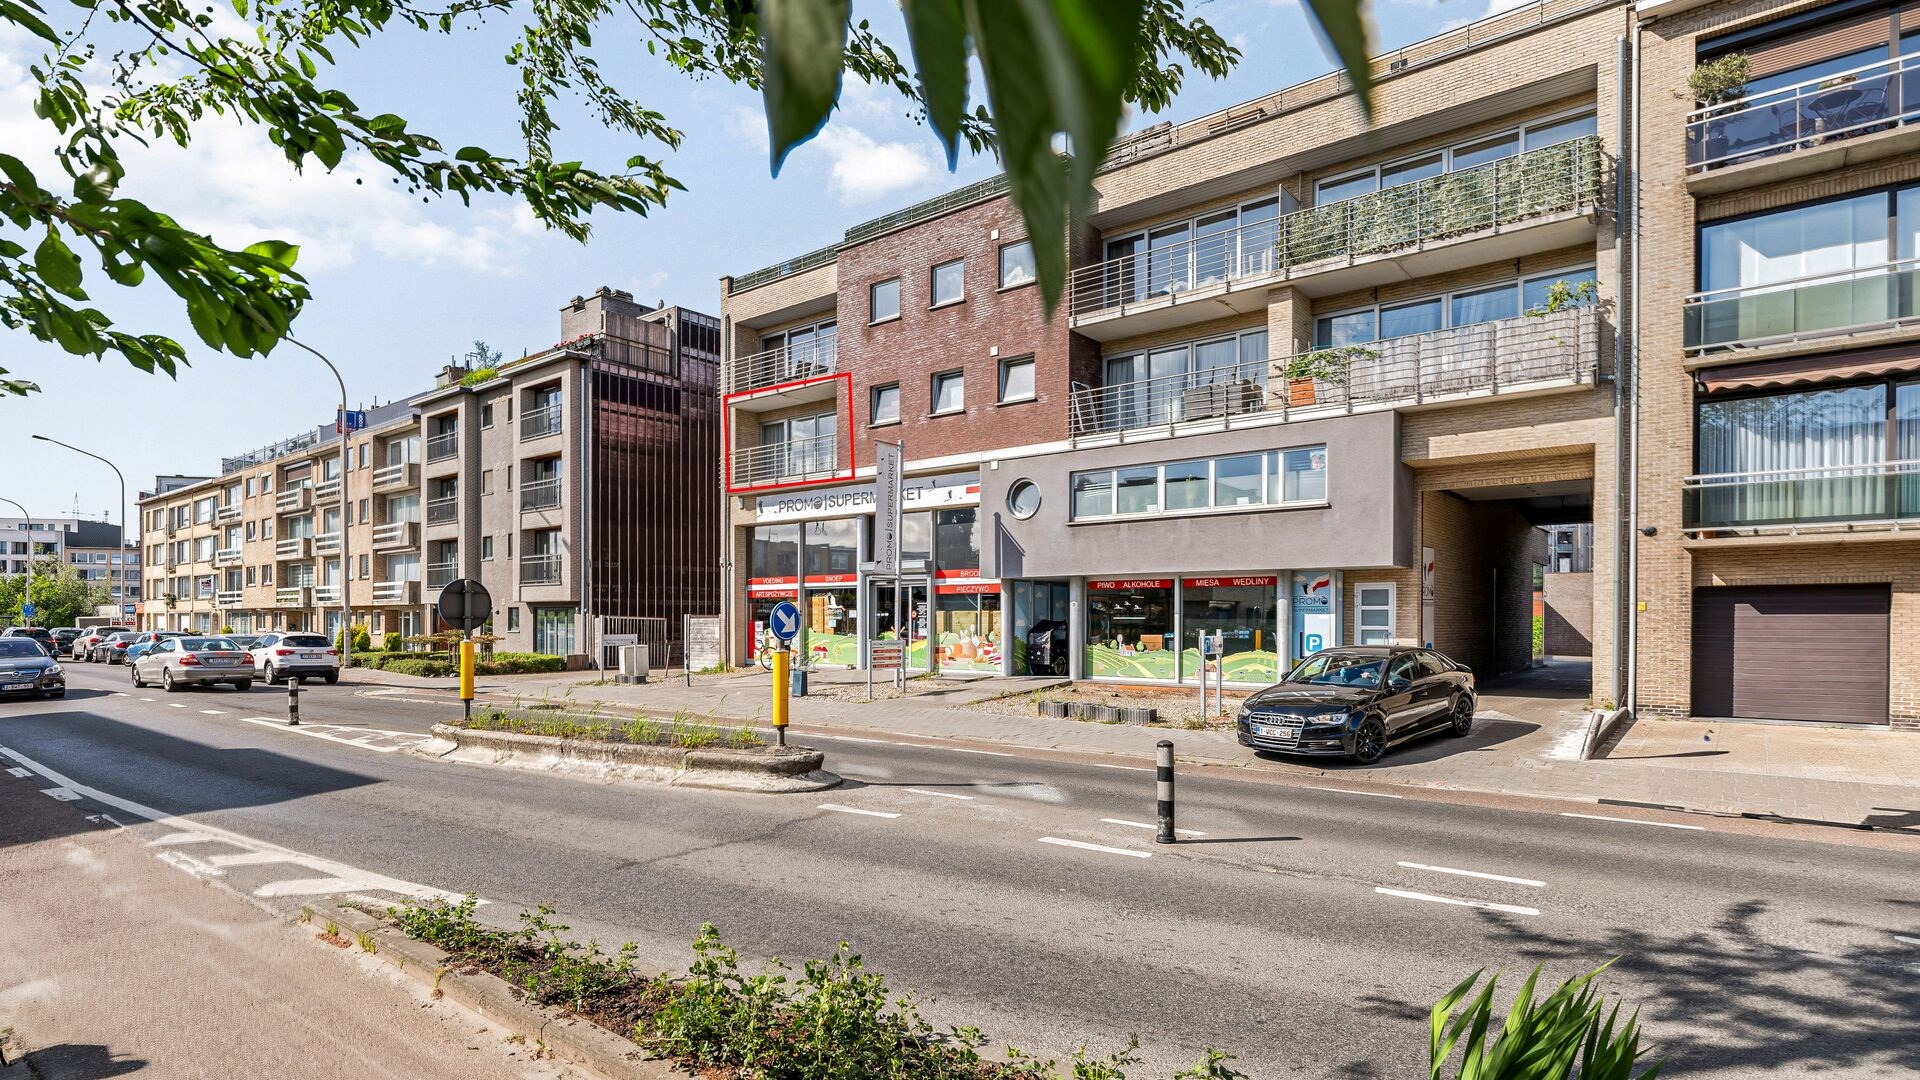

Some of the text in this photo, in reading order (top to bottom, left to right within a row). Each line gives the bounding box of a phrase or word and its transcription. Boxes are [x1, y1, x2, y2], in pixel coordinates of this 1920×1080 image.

[886, 453, 895, 529] SUPERMARKET
[960, 570, 980, 578] BROO
[824, 575, 843, 583] SNOEP
[1097, 580, 1160, 589] PIWO ALKOHOLE
[956, 585, 990, 593] PIECZYWO
[1309, 637, 1320, 651] P
